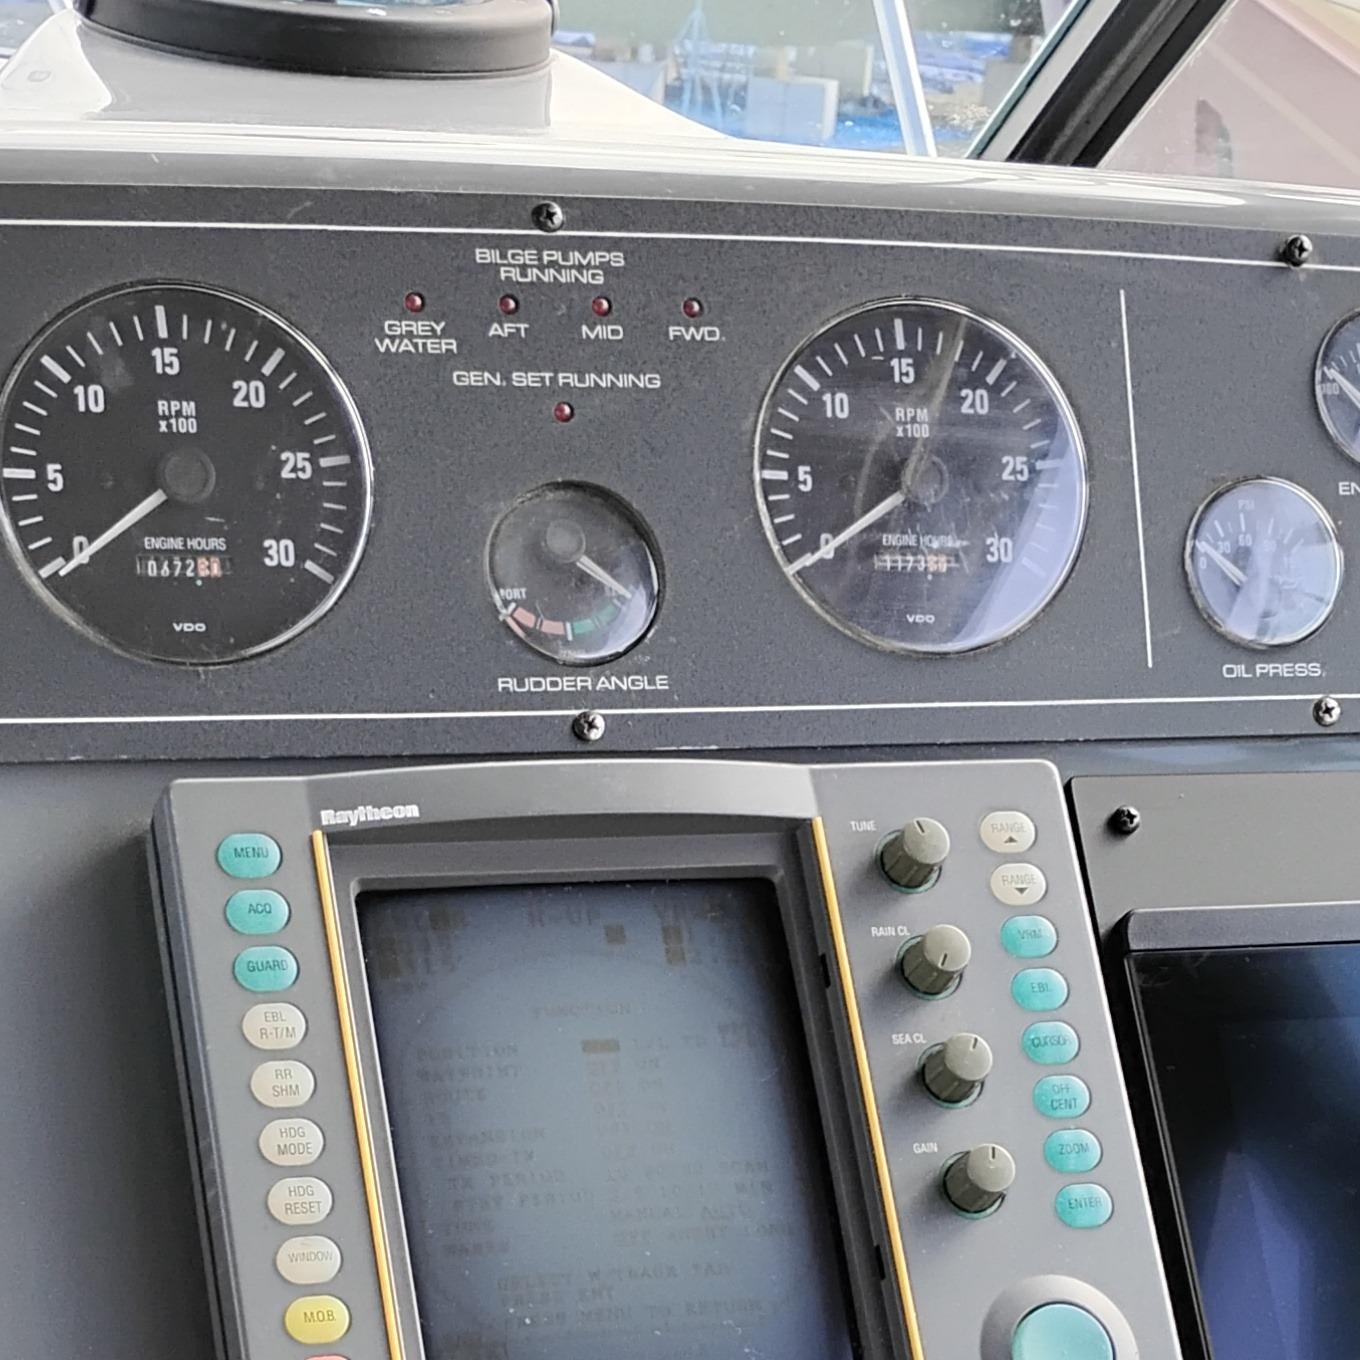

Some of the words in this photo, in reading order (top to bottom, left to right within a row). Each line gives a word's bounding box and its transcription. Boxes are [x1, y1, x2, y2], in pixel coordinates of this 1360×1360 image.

[475, 248, 538, 266] BILGE
[543, 250, 625, 268] PUMPS
[500, 267, 604, 284] RUNNING
[384, 321, 446, 337] GREY
[488, 323, 529, 338] AFT
[581, 324, 623, 340] MID
[668, 327, 725, 342] FWD.
[374, 337, 457, 354] WATER
[151, 347, 180, 375] 15
[890, 357, 915, 384] 15
[452, 371, 506, 387] GEN.
[512, 372, 553, 387] SET
[558, 373, 661, 389] RUNNING
[73, 384, 105, 413] 10
[232, 380, 266, 409] 20
[960, 388, 989, 415] 20
[157, 400, 197, 417] RPM
[822, 392, 849, 419] 10
[895, 407, 928, 422] RPM
[158, 417, 198, 434] x100
[896, 424, 930, 438] x100
[280, 452, 312, 480] 25
[1001, 456, 1029, 481] 25
[46, 463, 64, 492] 5
[797, 466, 813, 492] 5
[144, 536, 184, 550] ENGINE
[186, 537, 227, 551] HOURS
[986, 537, 1013, 563] 30
[263, 539, 295, 568] 30
[906, 614, 935, 624] VDO
[172, 622, 206, 632] VDO
[1222, 664, 1252, 678] OIL
[498, 676, 592, 692] RUDDER
[596, 675, 669, 691] ANGLE
[321, 803, 420, 827] Raytheon
[850, 821, 877, 832] TUNE
[990, 822, 1027, 835] RANGE
[234, 846, 269, 858] MENU
[1001, 873, 1037, 887] RANGE
[248, 903, 272, 914] ACQ
[246, 959, 289, 972] GUARD
[263, 1011, 287, 1023] EBL
[260, 1026, 297, 1041] R-T/M
[274, 1068, 294, 1081] RR
[272, 1083, 301, 1098] SHM
[1051, 1097, 1077, 1111] CENT
[279, 1126, 307, 1140] HDG
[277, 1142, 314, 1158] MODE
[913, 1142, 938, 1154] GAIN
[1059, 1143, 1089, 1155] ZOOM
[287, 1185, 315, 1199] HDG
[284, 1201, 323, 1216] RESET
[1068, 1197, 1103, 1210] ENTER
[287, 1250, 334, 1265] WINDOW
